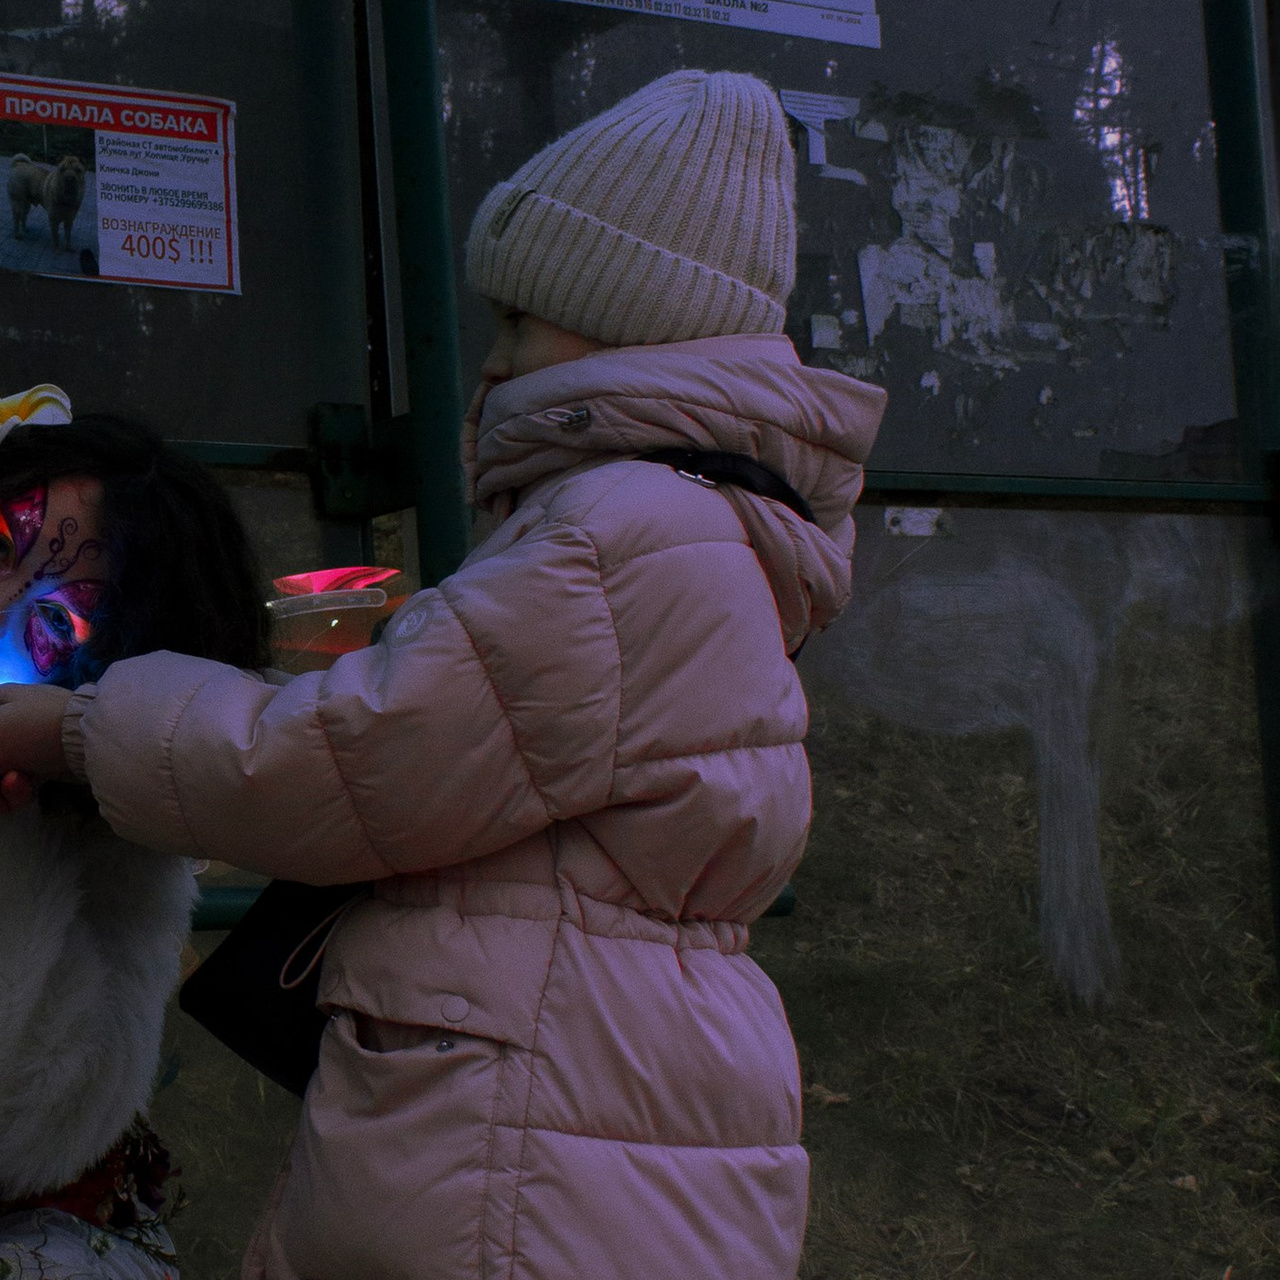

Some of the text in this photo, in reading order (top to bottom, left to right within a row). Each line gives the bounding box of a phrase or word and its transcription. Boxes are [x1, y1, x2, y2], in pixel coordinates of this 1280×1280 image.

[5, 97, 207, 134] ПРОПАЛА СОБАКА
[106, 137, 139, 149] районах
[100, 165, 129, 175] Кличка
[100, 183, 139, 193] ЗВОНИТЬ
[149, 188, 179, 198] ЛЮБОЕ
[181, 190, 208, 200] ВРЕМЯ
[100, 192, 112, 200] ПО
[114, 193, 148, 204] НОМЕРУ
[102, 218, 221, 239] ВОЗНАГРАЖДЕНИЕ
[122, 232, 213, 264] 400$ !!!
